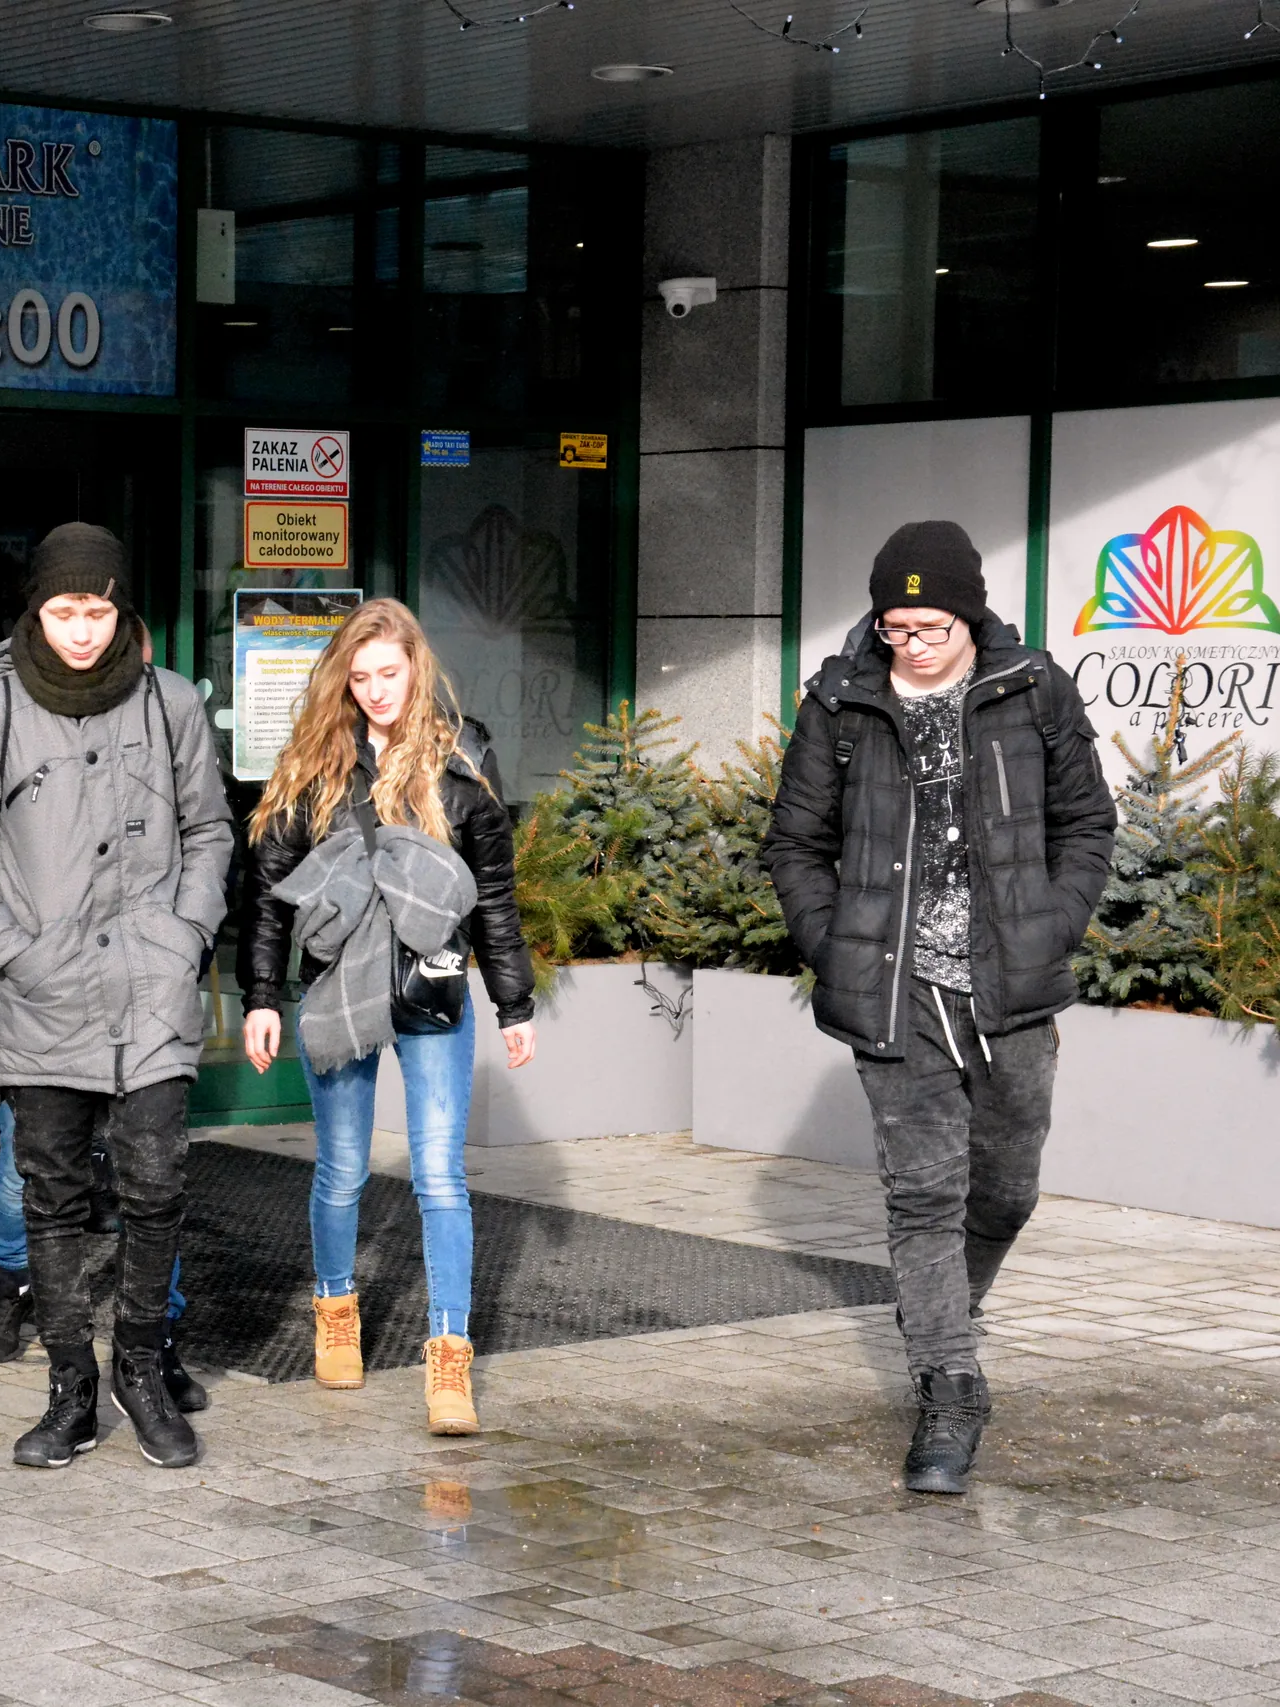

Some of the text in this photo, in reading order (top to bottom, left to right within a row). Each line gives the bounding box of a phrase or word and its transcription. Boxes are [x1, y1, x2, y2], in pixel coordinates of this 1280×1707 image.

[252, 441, 298, 455] ZAKAZ
[252, 458, 308, 472] PALENIA
[261, 483, 288, 491] TERENIE
[288, 484, 315, 492] CAŁEGO
[276, 513, 317, 526] Obiekt
[252, 528, 340, 544] monitorowany
[259, 544, 334, 557] całodobowo
[254, 616, 285, 626] WODY
[1108, 644, 1280, 661] SALON KOSMETYCZNY
[1072, 652, 1280, 726] COLORI
[1129, 710, 1141, 727] a
